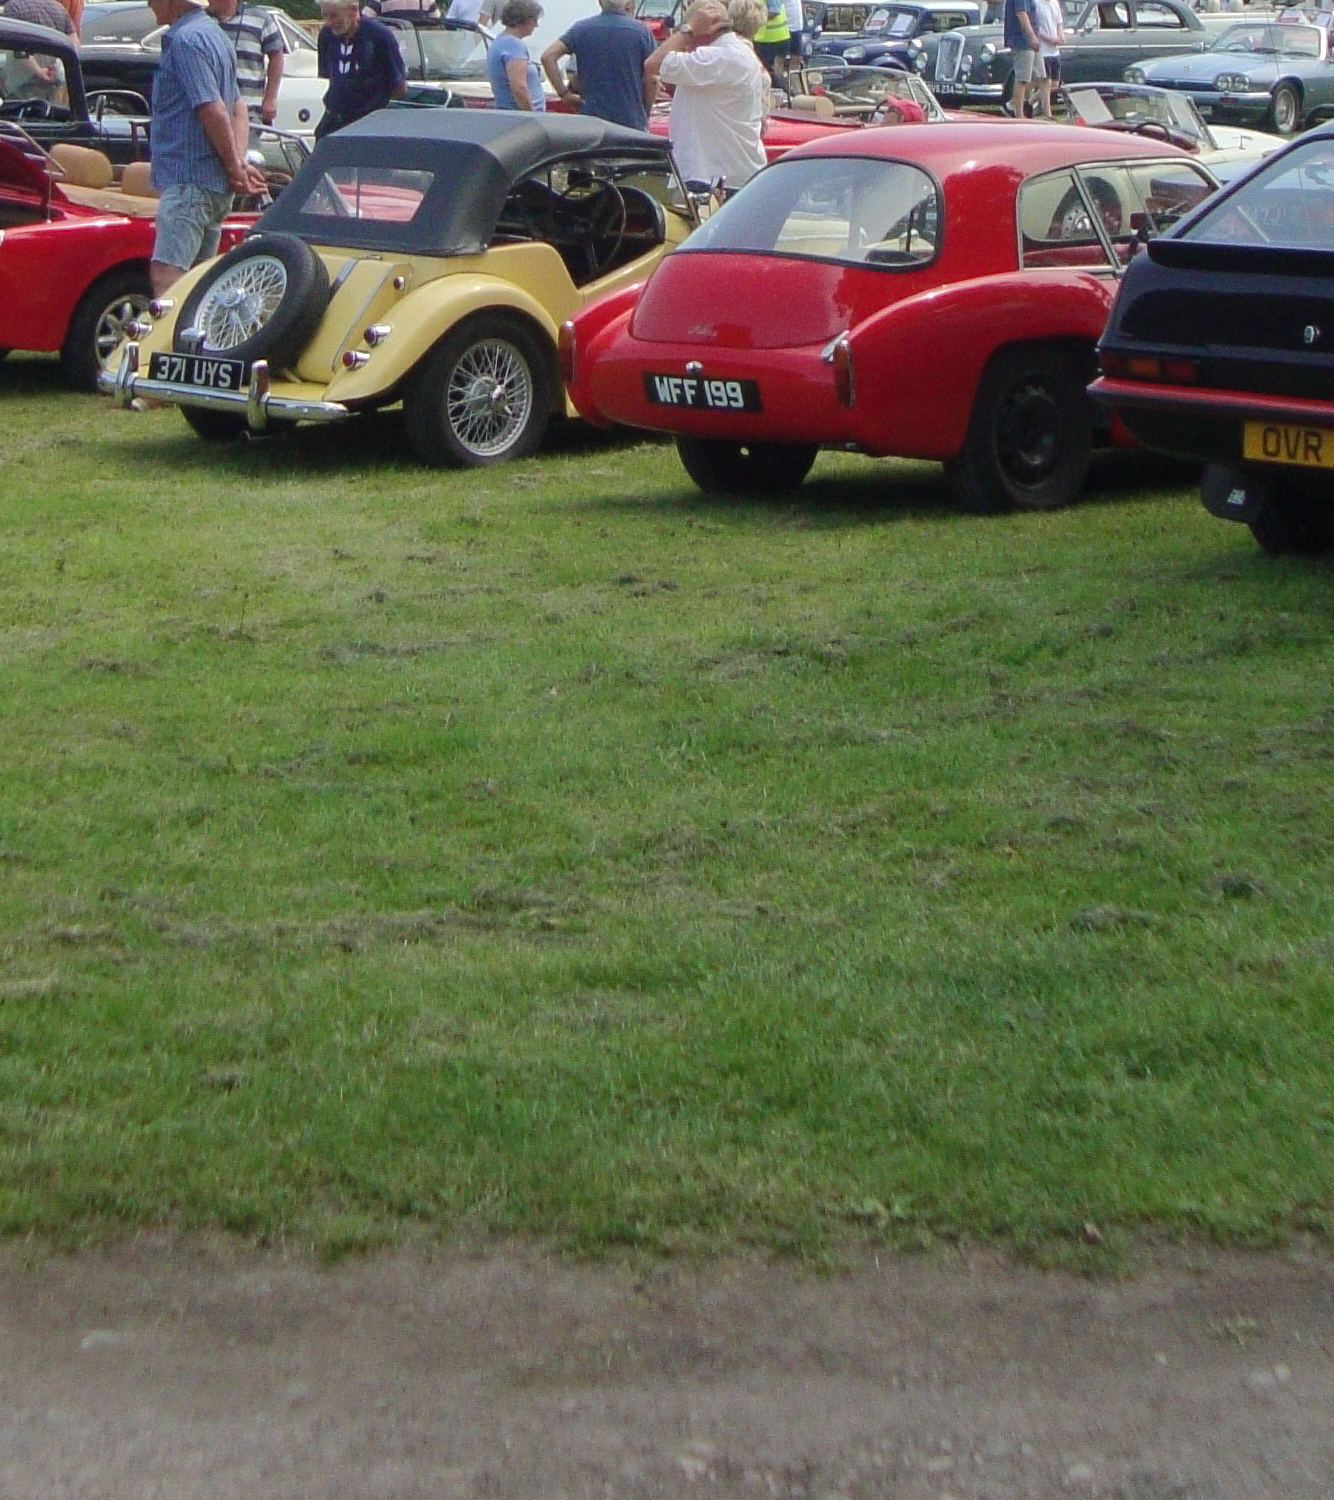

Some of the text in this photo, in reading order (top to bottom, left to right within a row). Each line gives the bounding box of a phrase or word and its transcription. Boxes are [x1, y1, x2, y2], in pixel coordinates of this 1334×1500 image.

[156, 355, 233, 388] 371 UYS
[654, 376, 745, 408] WFF 199
[1262, 426, 1322, 462] OVR
